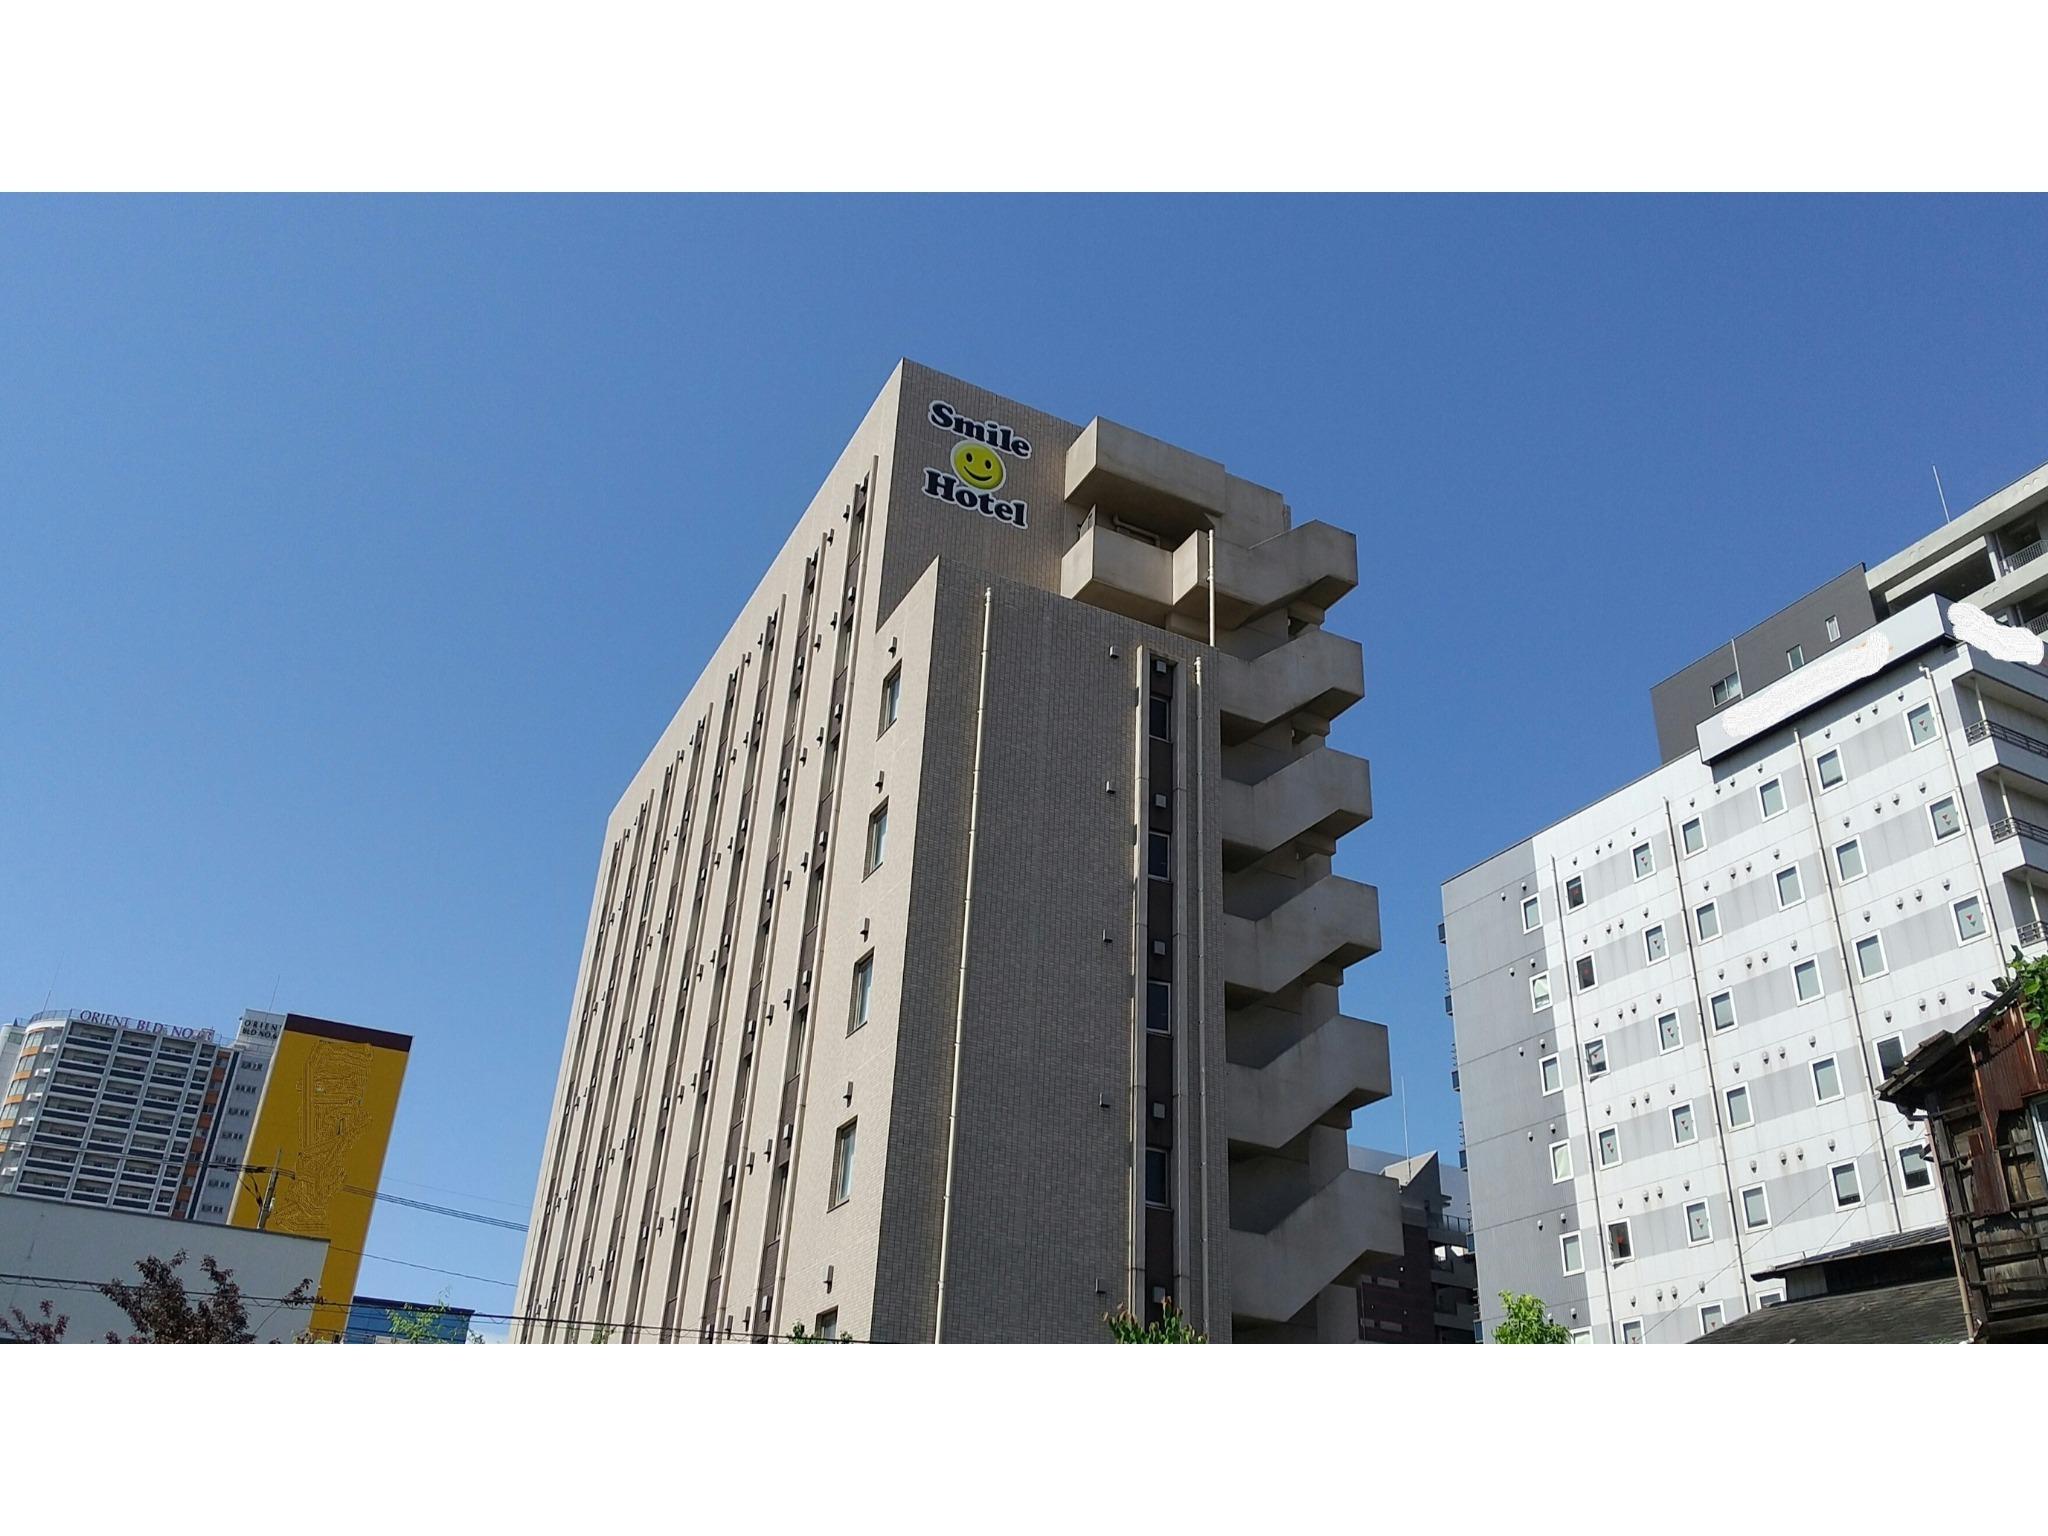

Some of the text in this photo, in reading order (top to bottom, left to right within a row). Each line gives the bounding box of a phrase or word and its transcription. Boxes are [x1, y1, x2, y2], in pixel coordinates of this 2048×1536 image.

[929, 401, 1032, 458] Smile
[922, 468, 1028, 528] Hotel
[80, 1010, 130, 1029] ORIENT
